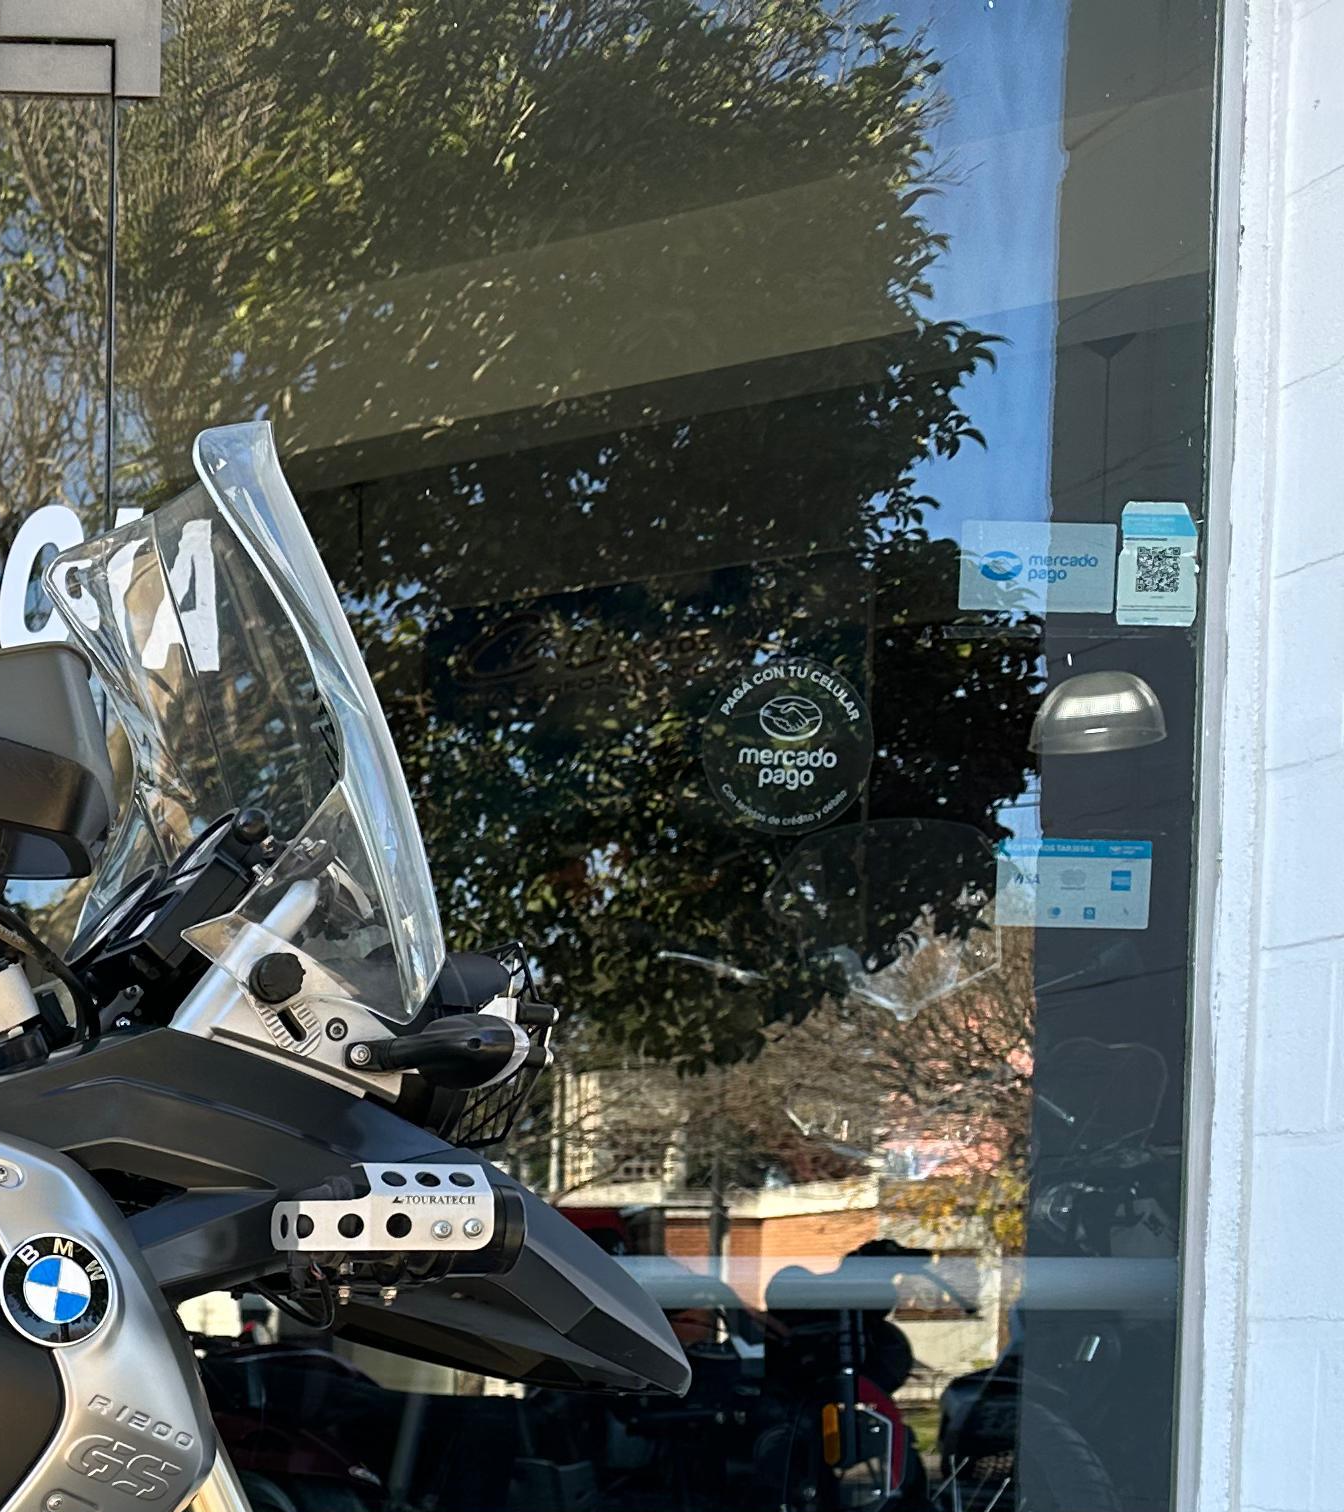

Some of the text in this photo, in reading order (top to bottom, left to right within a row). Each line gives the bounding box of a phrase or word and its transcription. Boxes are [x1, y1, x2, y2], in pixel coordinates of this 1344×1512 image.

[1028, 554, 1099, 567] mercado
[1028, 569, 1068, 583] pago
[752, 666, 785, 685] CON
[787, 665, 809, 679] TU
[810, 671, 860, 722] CELULAR
[738, 746, 837, 768] mercado
[758, 768, 814, 790] pago
[405, 1195, 476, 1205] TOURATECH
[16, 1237, 106, 1282] BMW
[64, 1434, 182, 1500] GS
